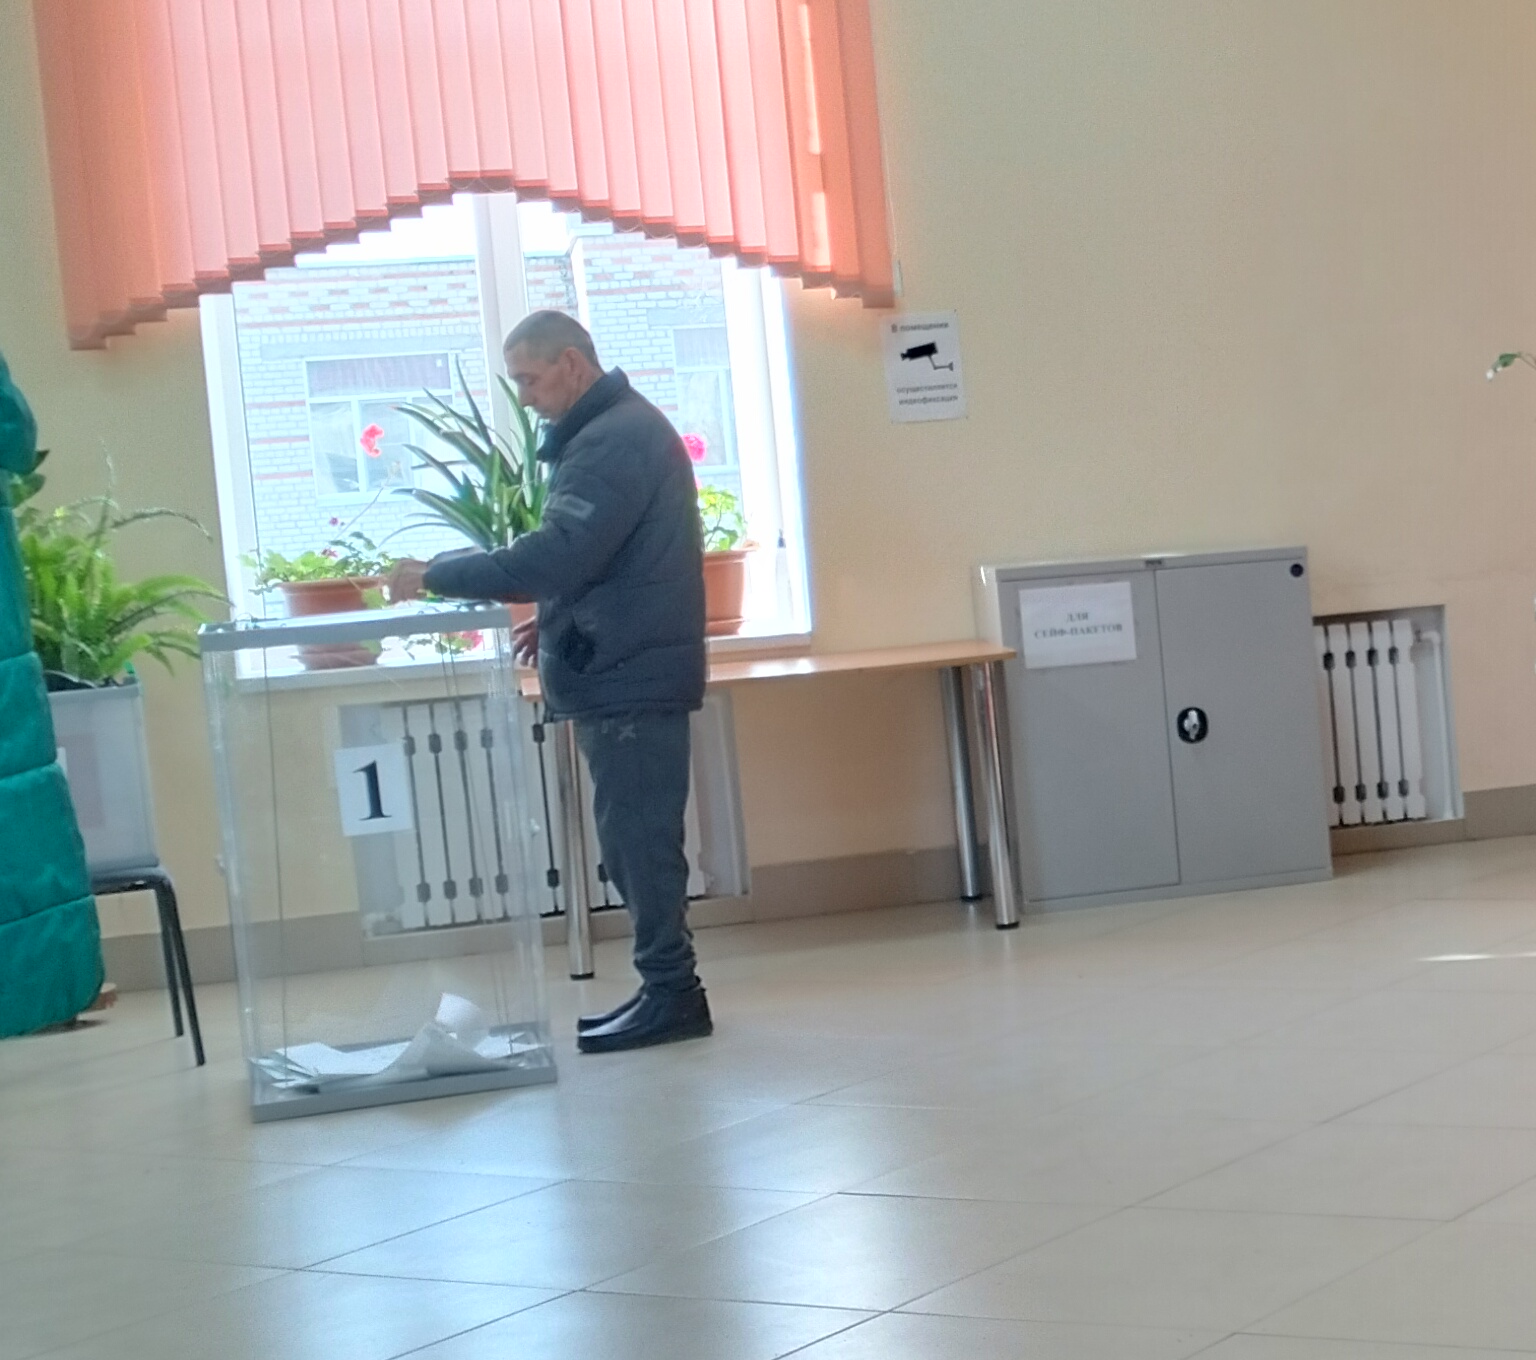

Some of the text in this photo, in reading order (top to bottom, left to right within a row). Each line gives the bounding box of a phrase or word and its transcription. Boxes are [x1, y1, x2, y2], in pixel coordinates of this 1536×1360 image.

[1067, 612, 1089, 623] ДЛЯ
[1034, 623, 1123, 639] СЕЙФ-ПАКЕТОВ
[352, 759, 393, 822] 1
